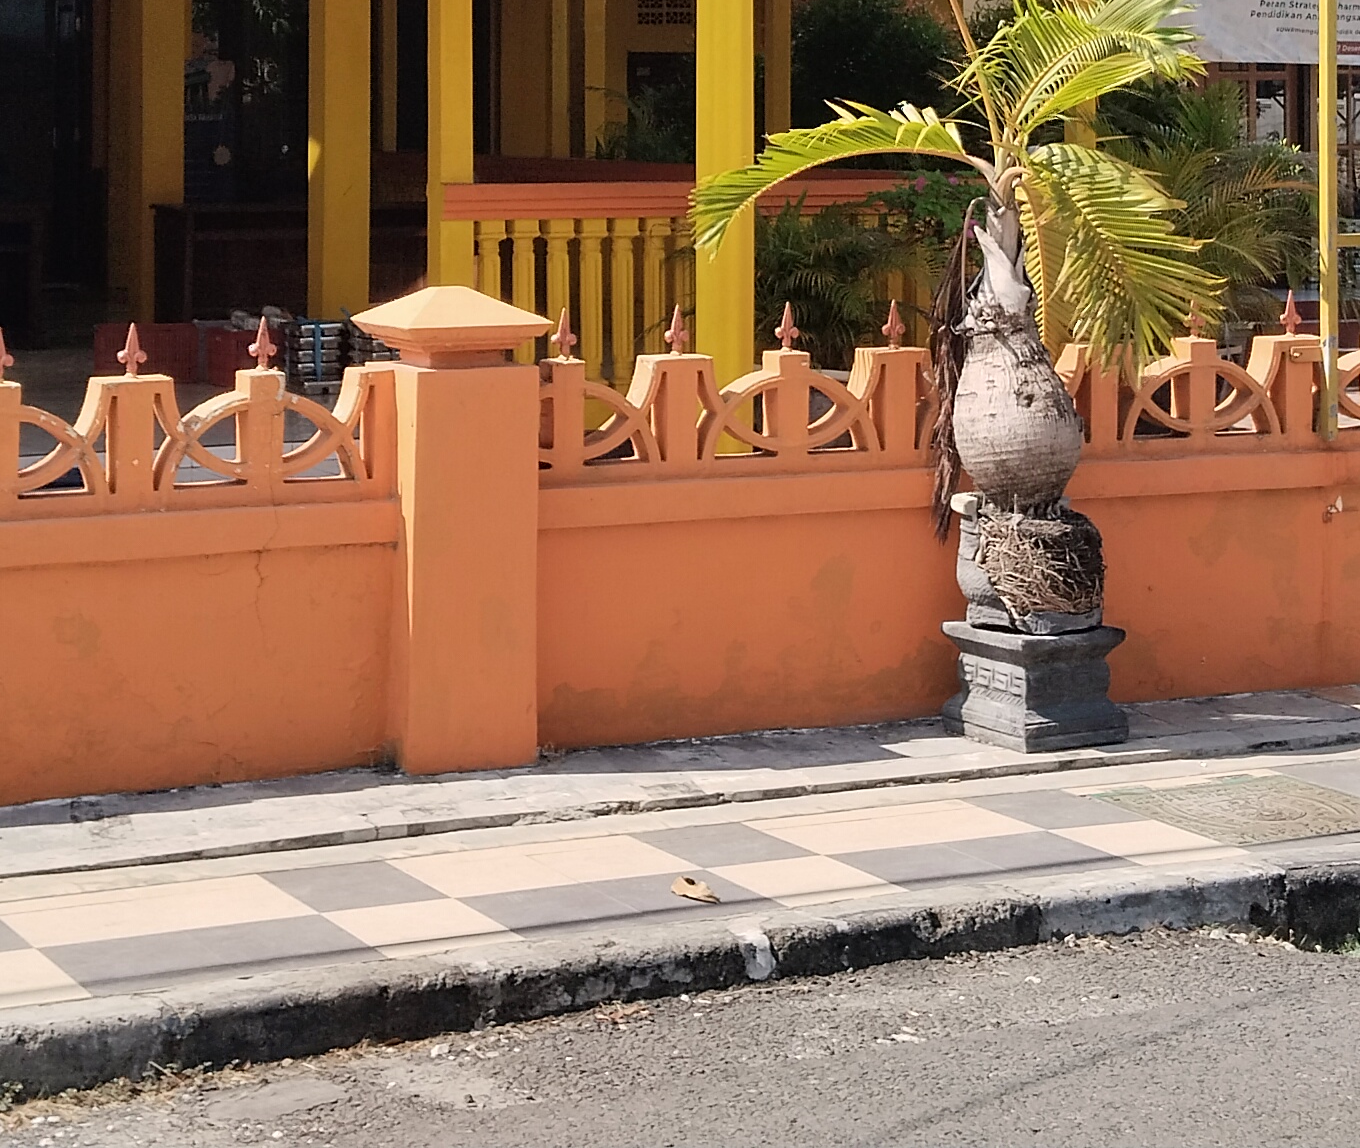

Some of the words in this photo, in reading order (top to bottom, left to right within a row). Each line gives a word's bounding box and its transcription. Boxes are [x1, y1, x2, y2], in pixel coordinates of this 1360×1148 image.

[1260, 0, 1286, 9] Peran
[1250, 10, 1303, 20] Pendidikan
[1336, 14, 1360, 23] angsa
